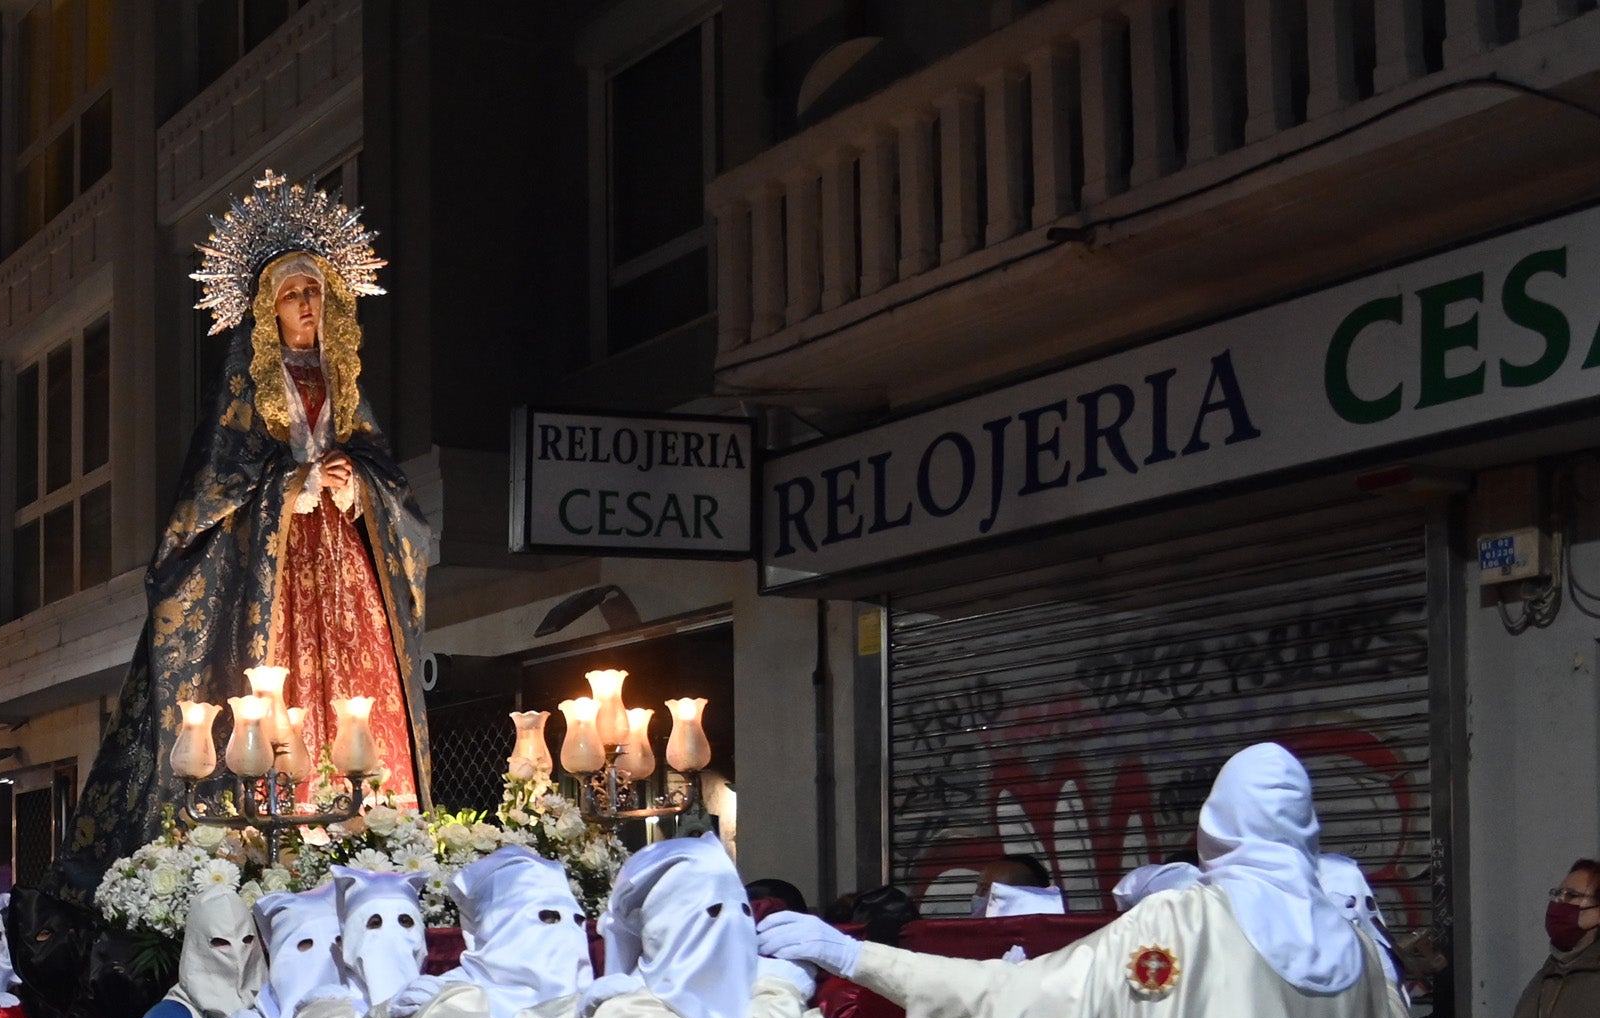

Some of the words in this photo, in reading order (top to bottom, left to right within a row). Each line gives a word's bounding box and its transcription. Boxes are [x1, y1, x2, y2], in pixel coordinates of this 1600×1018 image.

[773, 348, 1261, 557] RELOJERIA
[1324, 246, 1600, 425] CES
[538, 424, 745, 472] RELOJERIA
[558, 488, 723, 539] CESAR
